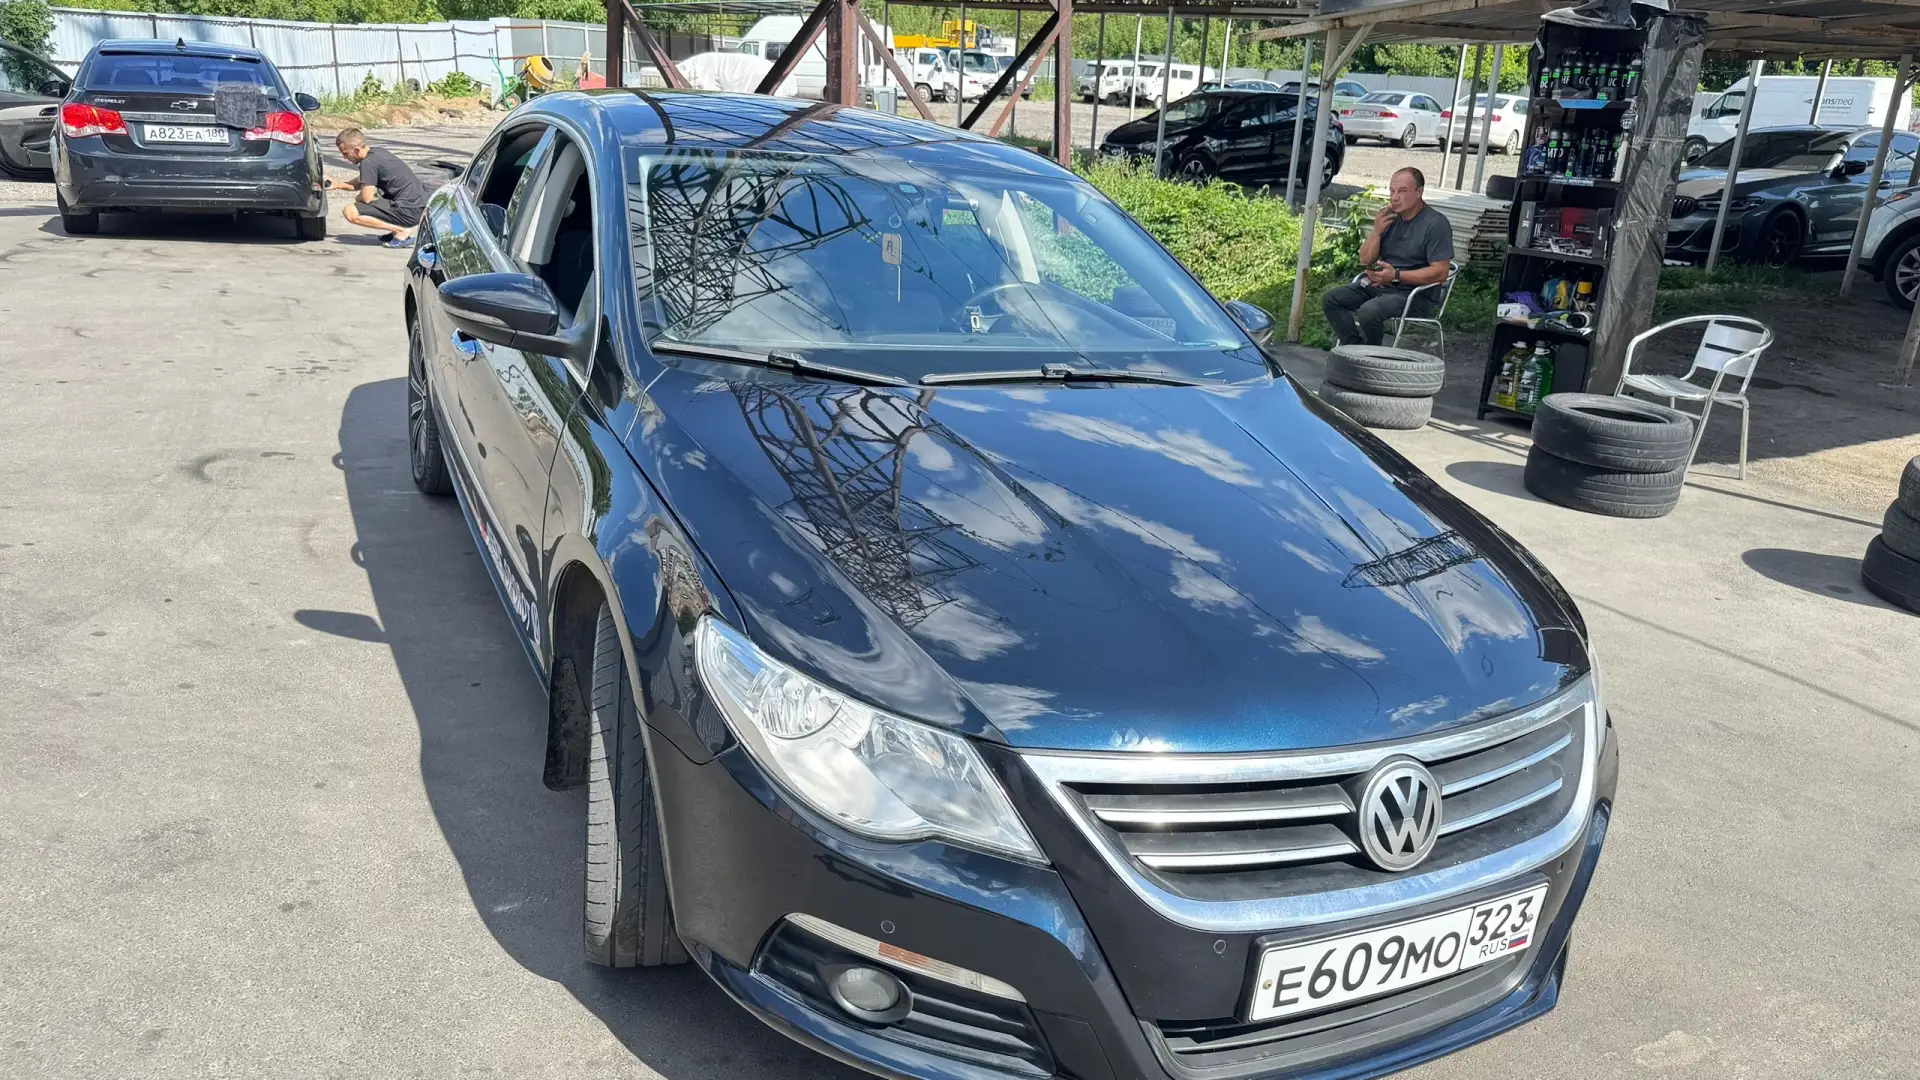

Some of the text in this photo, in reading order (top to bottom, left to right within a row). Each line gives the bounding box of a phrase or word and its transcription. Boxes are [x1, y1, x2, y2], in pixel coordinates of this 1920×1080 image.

[205, 128, 225, 138] 180
[1470, 896, 1534, 946] 323
[1479, 938, 1508, 958] RUS
